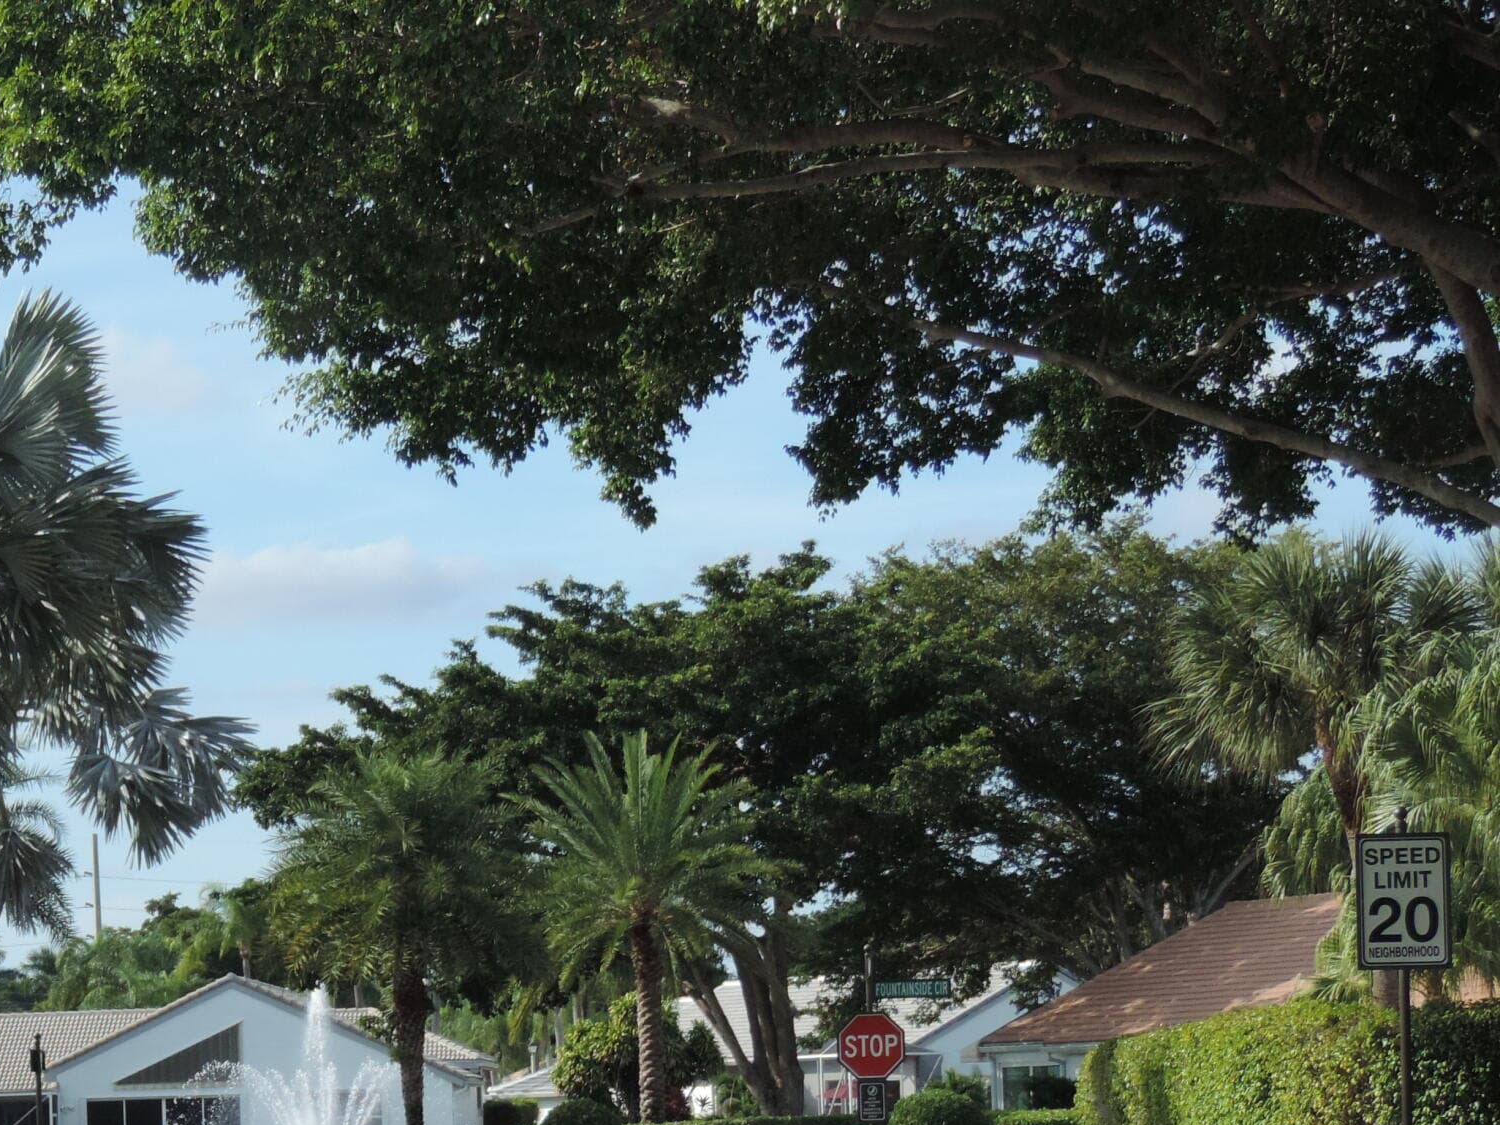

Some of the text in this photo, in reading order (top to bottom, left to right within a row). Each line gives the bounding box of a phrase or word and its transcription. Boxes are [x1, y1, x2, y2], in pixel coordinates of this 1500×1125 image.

[1364, 847, 1440, 865] SPEED
[1374, 871, 1432, 889] LIMIT
[1368, 896, 1439, 943] 20
[1368, 946, 1440, 958] NEIGHBORHOOD
[875, 981, 948, 996] FOUNTAINSIDE CIR
[845, 1034, 898, 1058] STOP
